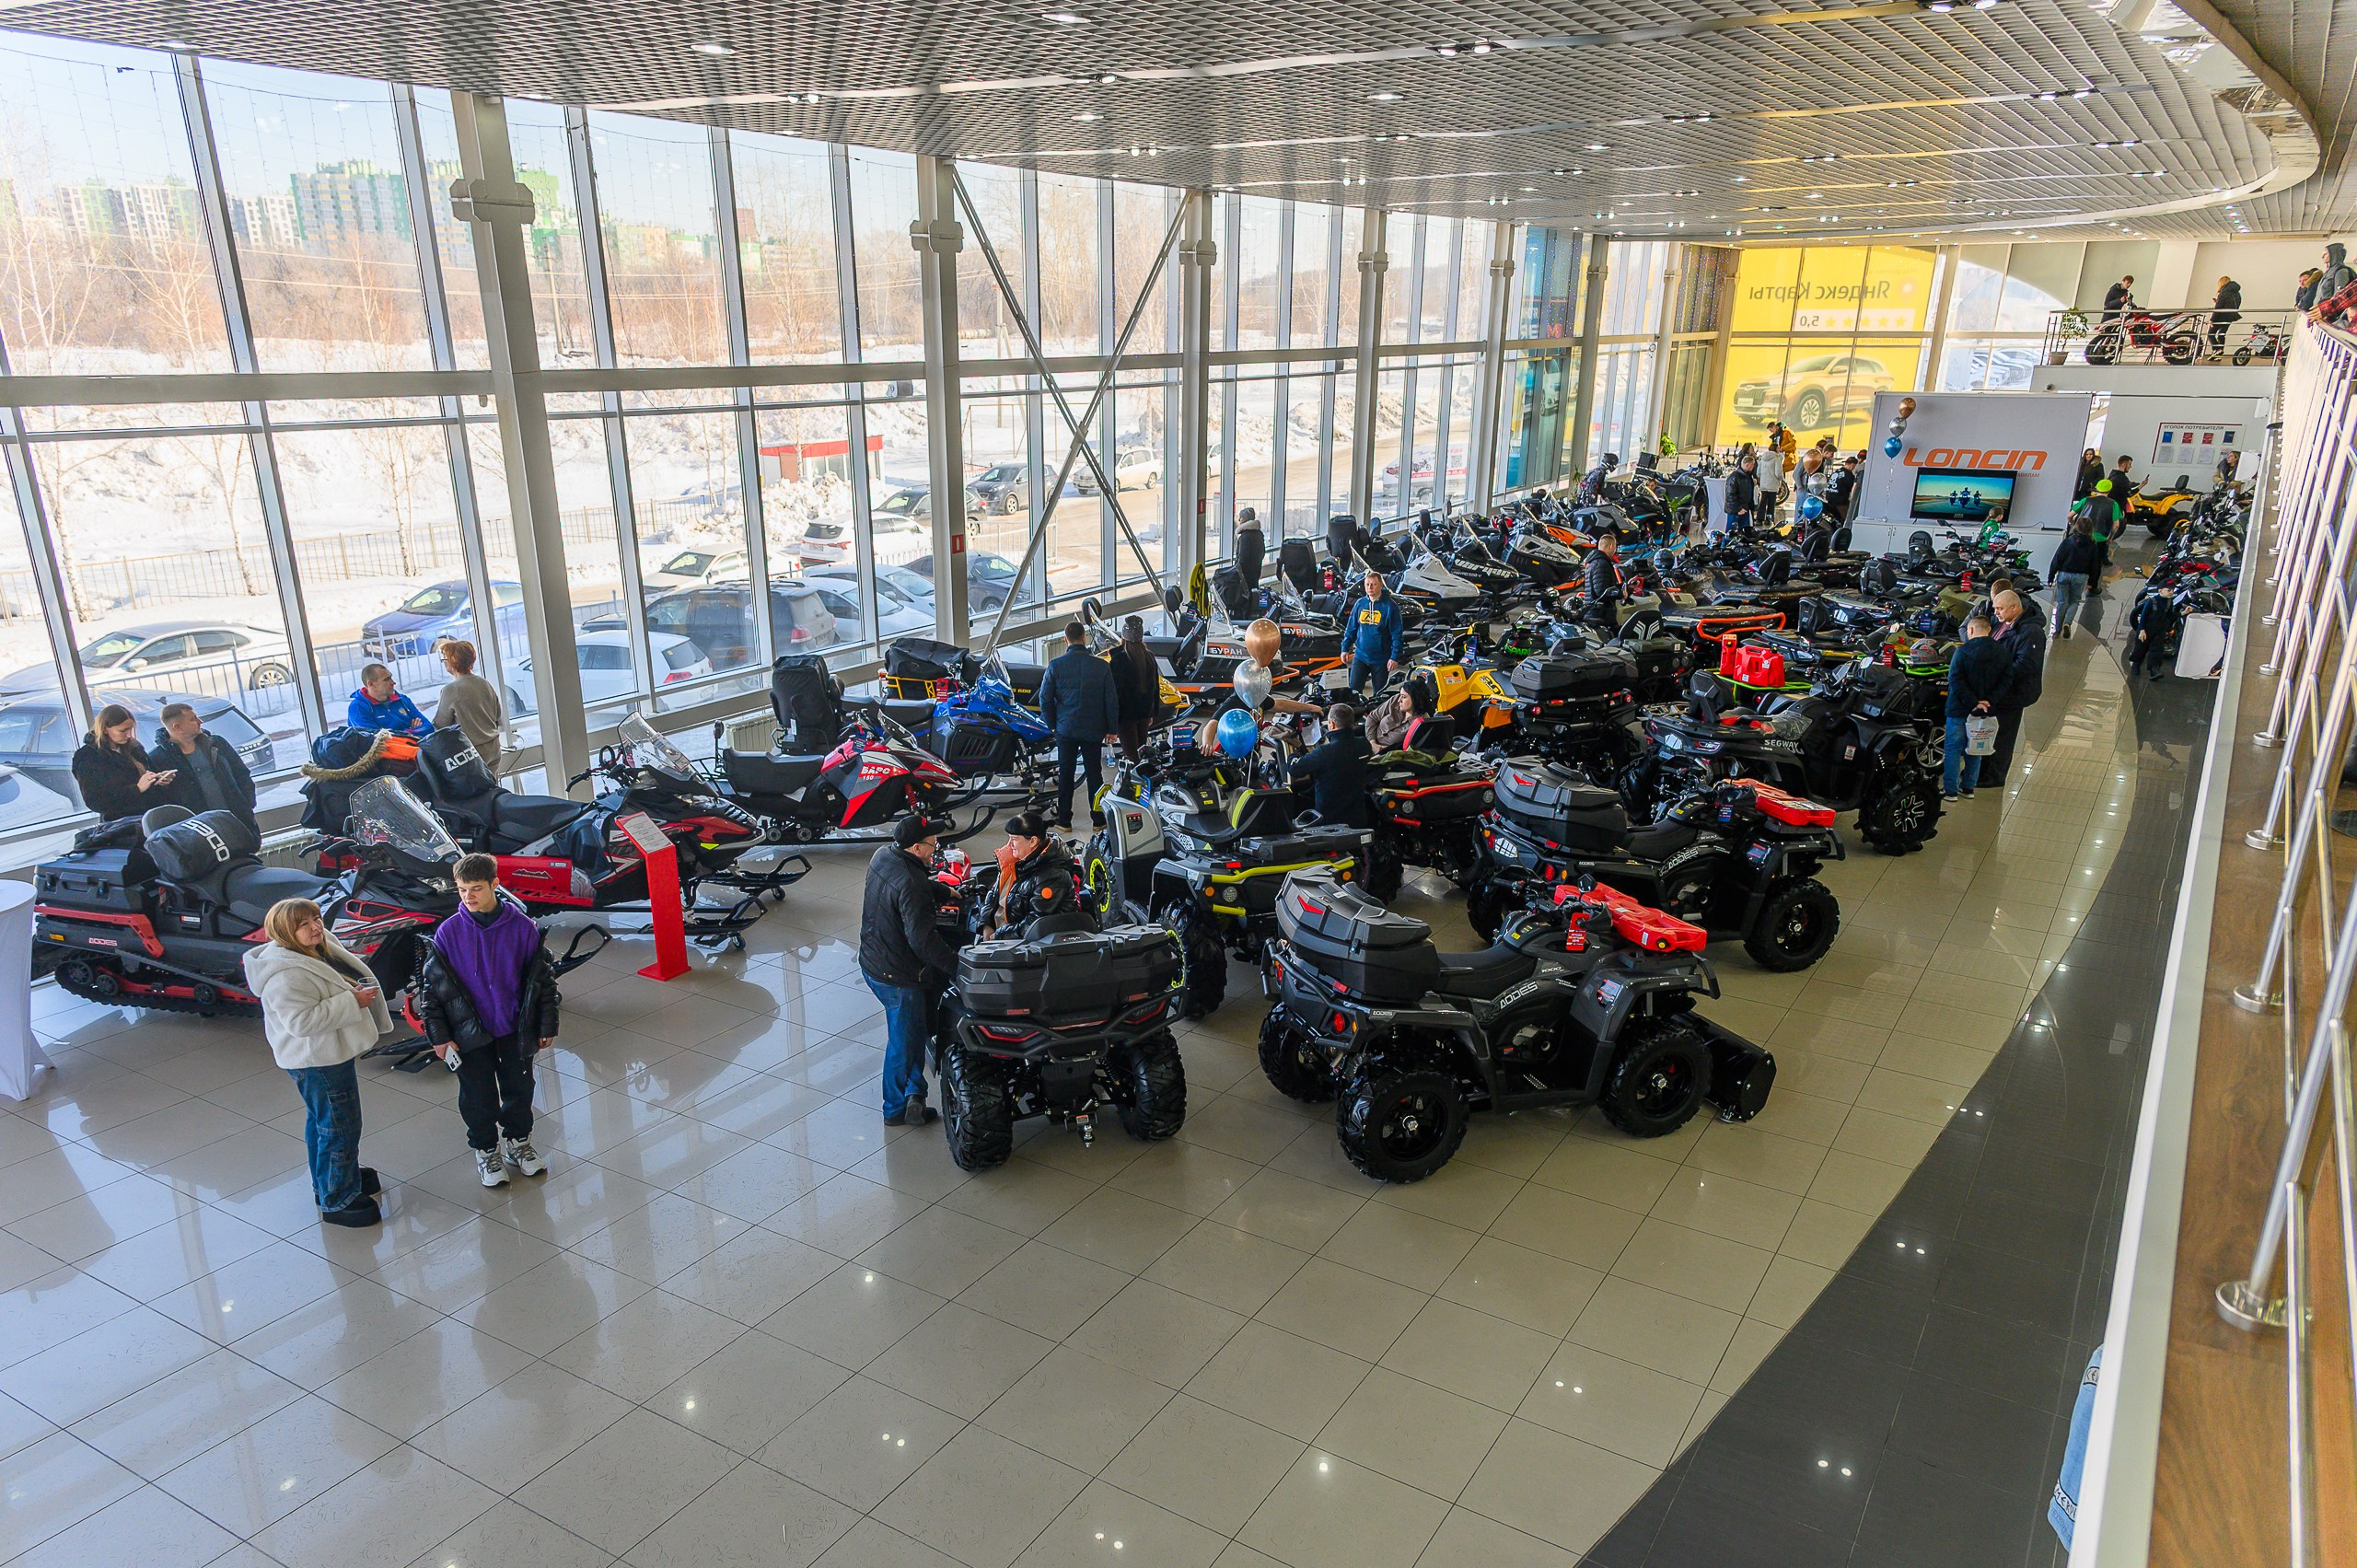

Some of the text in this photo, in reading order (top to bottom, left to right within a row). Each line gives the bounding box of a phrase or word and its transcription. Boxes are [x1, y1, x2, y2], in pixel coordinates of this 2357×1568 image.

[1903, 447, 2048, 470] LONCIN
[1212, 646, 1243, 656] БУРАН
[1764, 738, 1799, 749] SEGWAY
[445, 746, 480, 772] AODE
[862, 765, 891, 775] БАРС
[89, 937, 118, 947] AODES
[1500, 981, 1538, 1010] AODES
